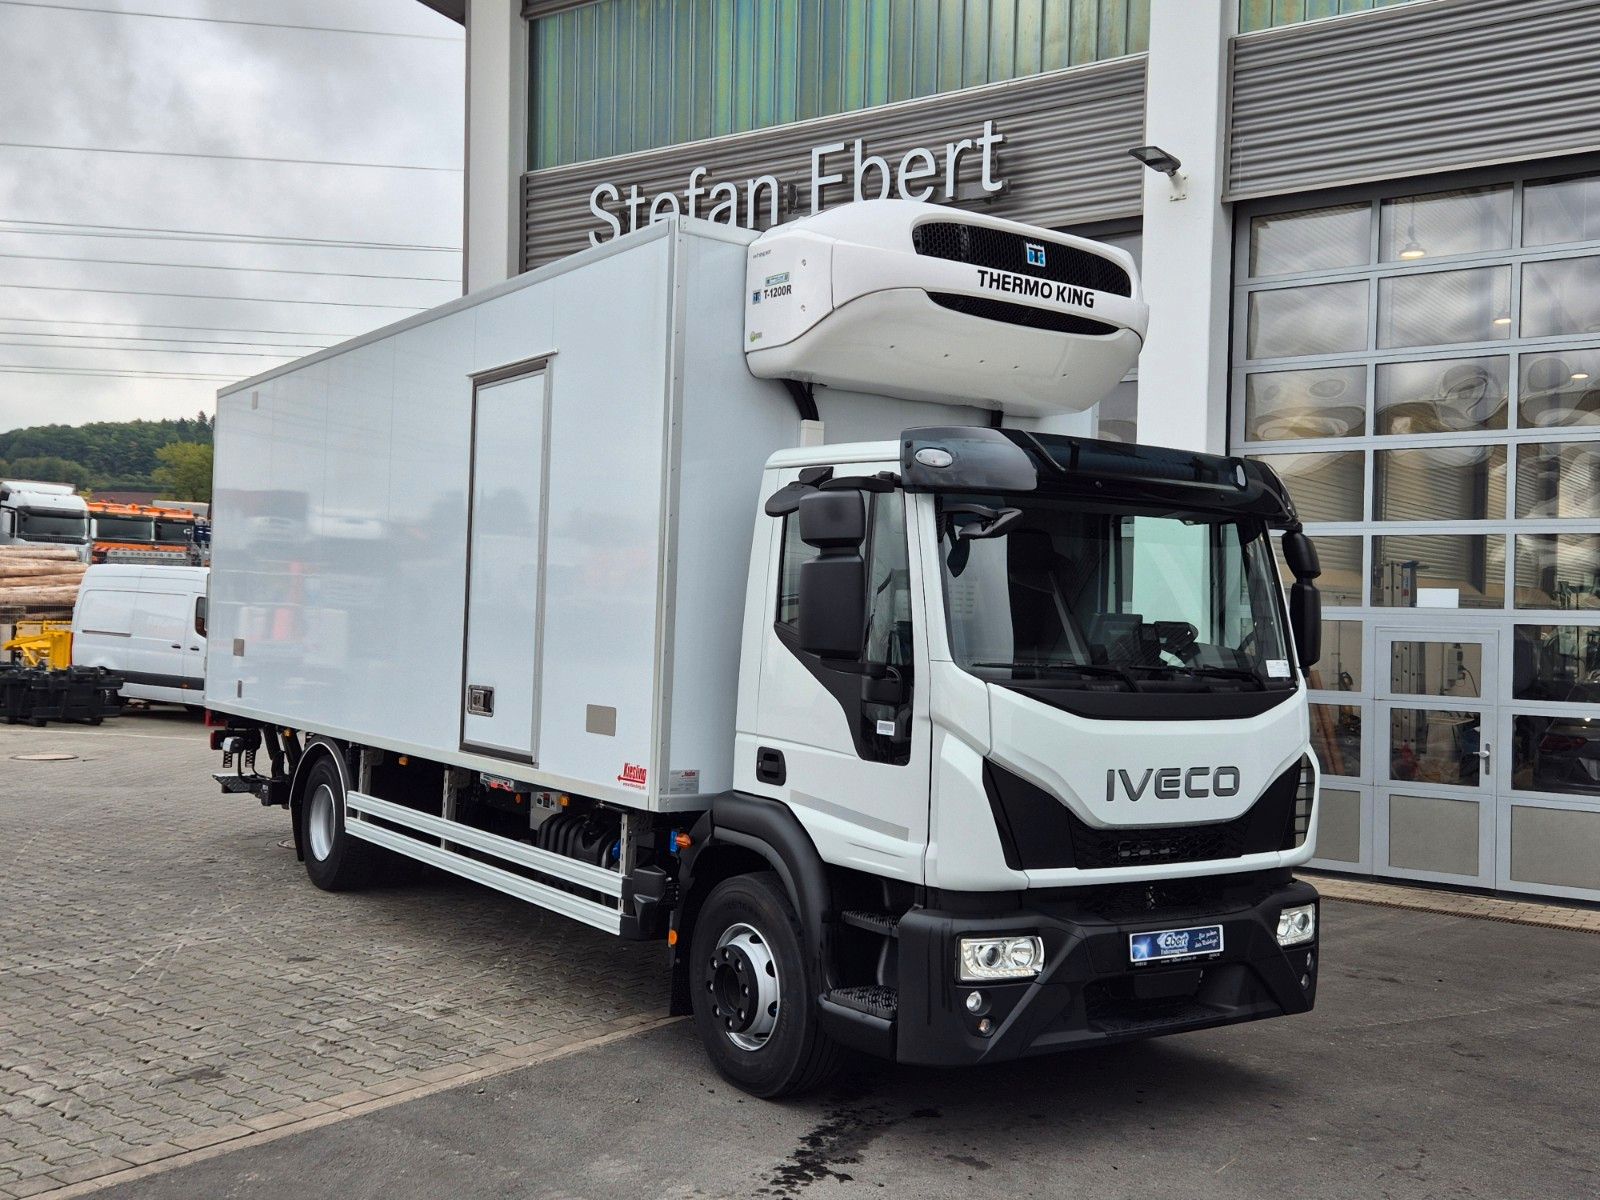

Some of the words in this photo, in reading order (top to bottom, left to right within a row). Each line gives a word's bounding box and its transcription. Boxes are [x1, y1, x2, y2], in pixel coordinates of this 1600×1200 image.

[588, 166, 779, 247] Stefan
[763, 284, 792, 300] T-1200R
[977, 269, 1053, 299] THERMO
[1055, 285, 1095, 309] KING
[1106, 766, 1240, 801] IVECO
[1164, 933, 1188, 947] Ebert
